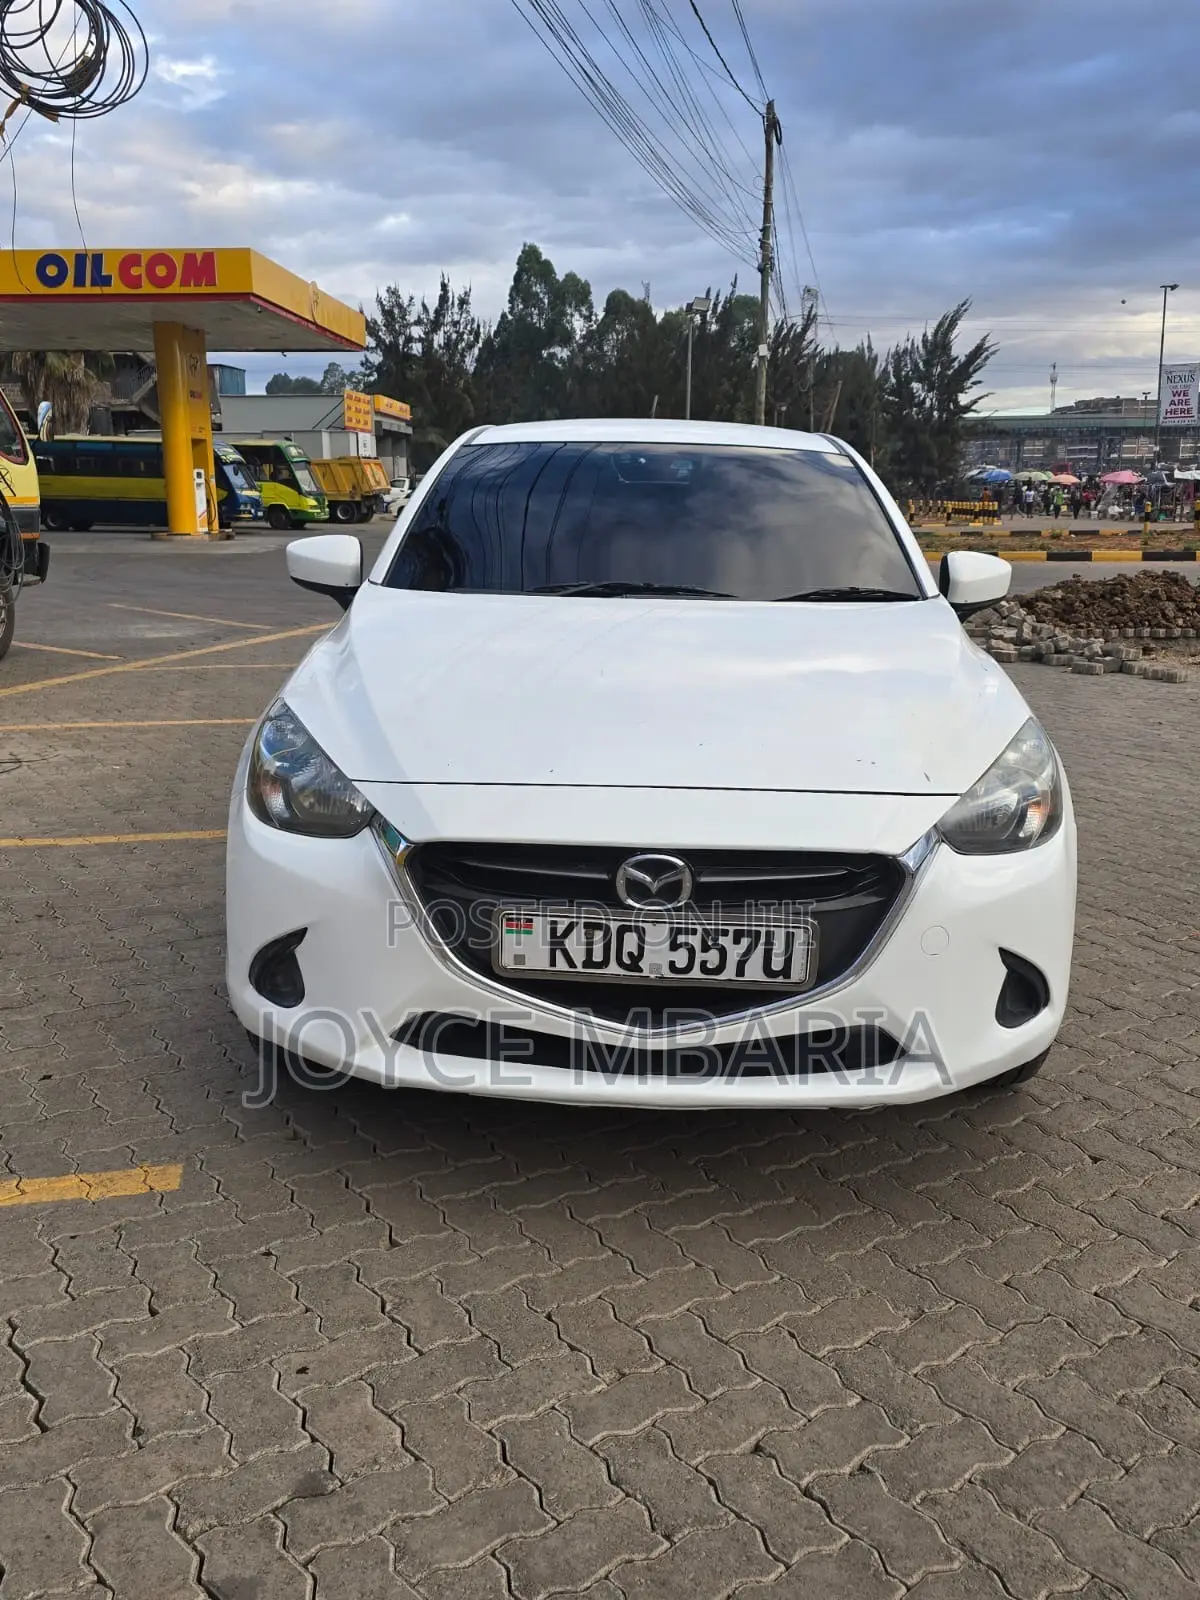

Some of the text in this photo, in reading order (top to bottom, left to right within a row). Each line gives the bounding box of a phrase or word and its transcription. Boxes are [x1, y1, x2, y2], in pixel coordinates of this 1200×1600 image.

[36, 251, 217, 289] OILCOM
[1167, 374, 1195, 384] NEXUS
[1169, 399, 1192, 407] ARE
[1165, 408, 1193, 416] HERE
[549, 919, 646, 973] KDQ
[668, 926, 795, 980] 557U
